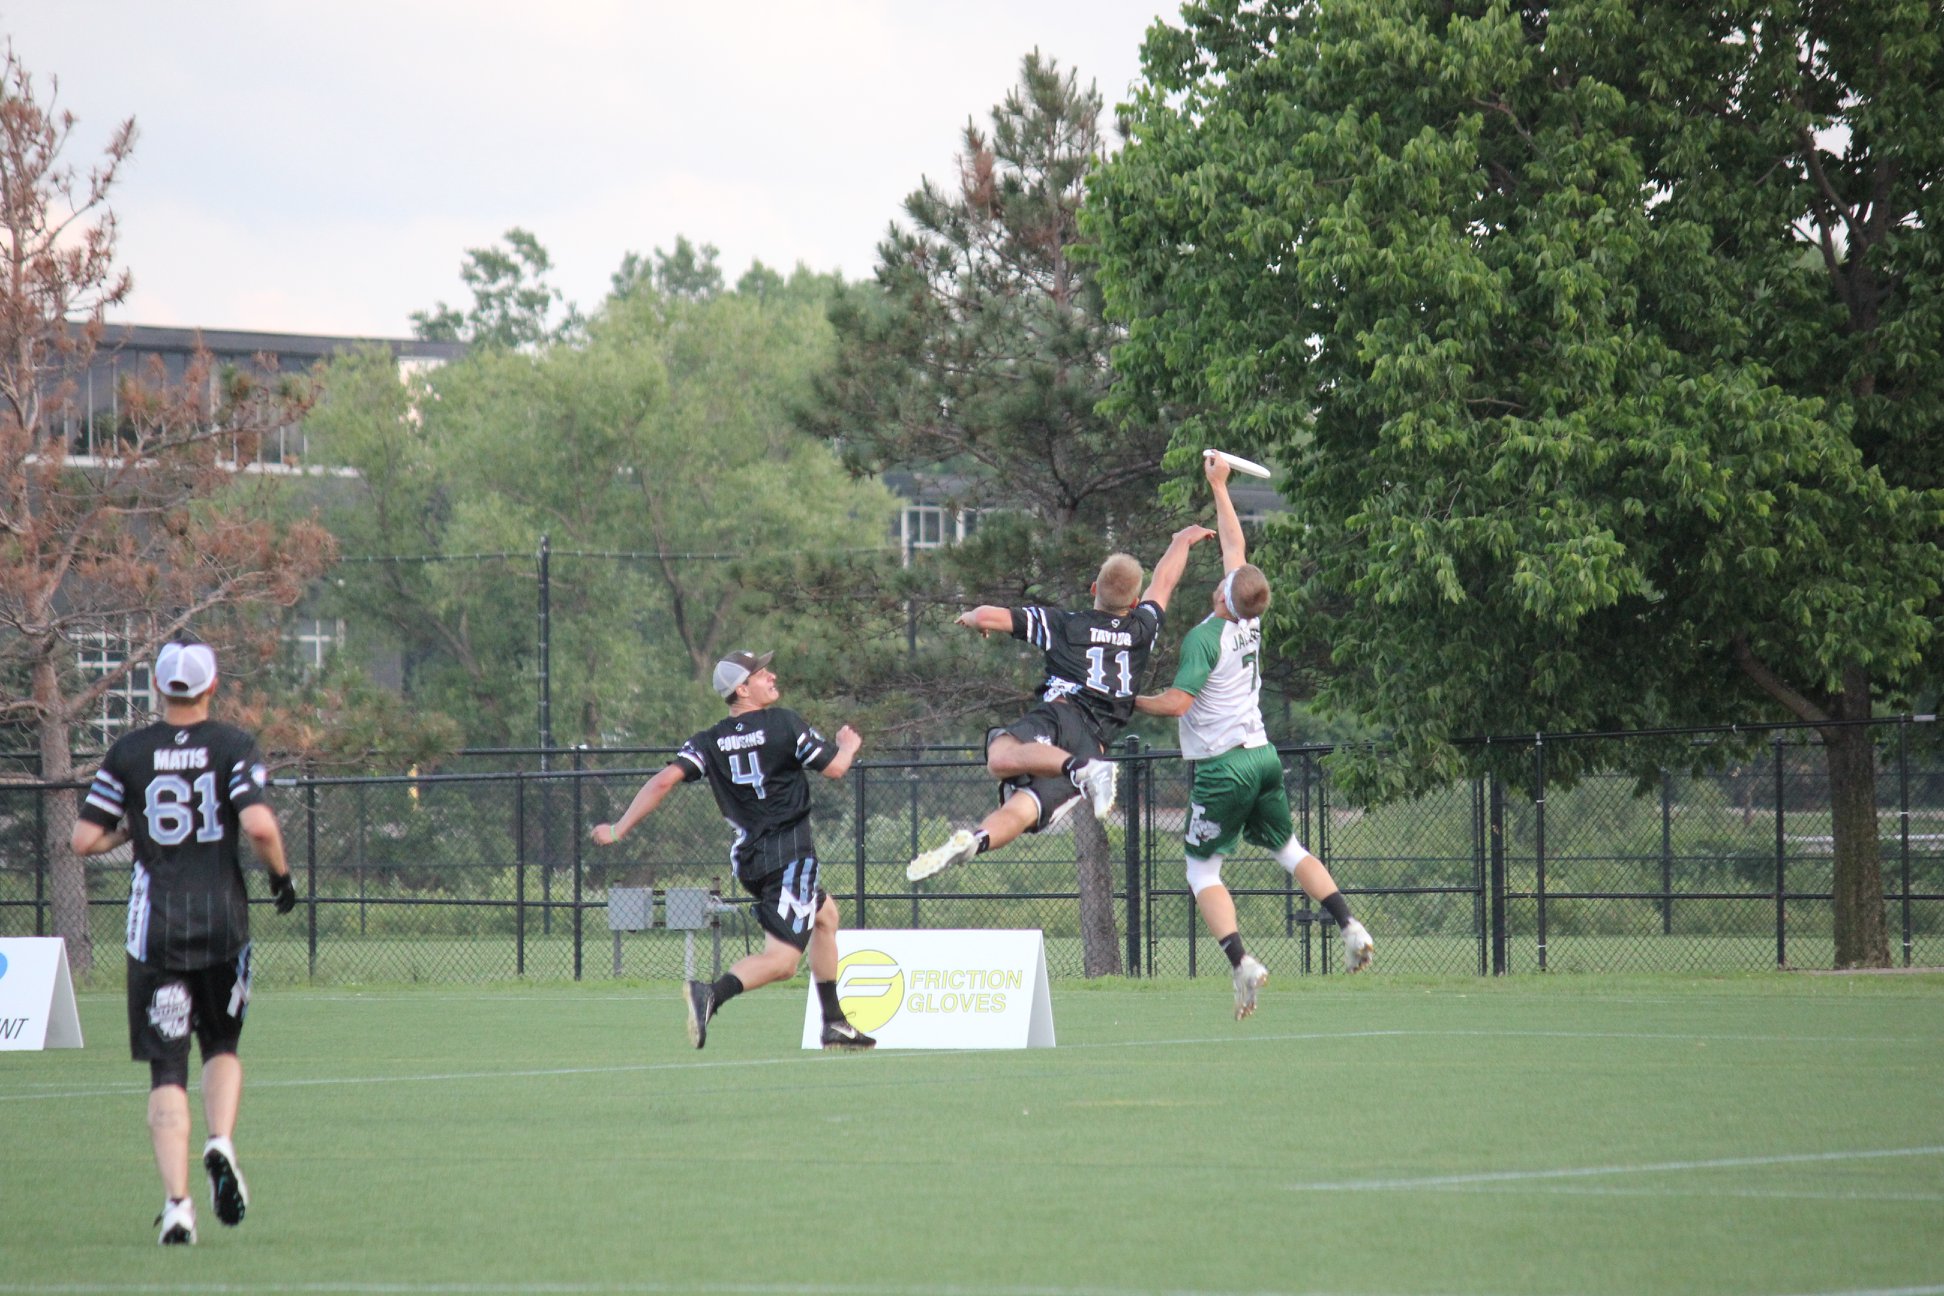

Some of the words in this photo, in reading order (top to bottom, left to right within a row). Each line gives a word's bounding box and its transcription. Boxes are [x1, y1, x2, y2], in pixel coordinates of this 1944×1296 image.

[1086, 646, 1133, 698] 11
[717, 730, 765, 752] COUSINS
[154, 747, 208, 770] MATIS
[728, 751, 766, 799] 4
[143, 771, 223, 845] 61
[909, 970, 1023, 990] FRICTION
[907, 993, 1007, 1014] GLOVES
[0, 1018, 29, 1039] NT
